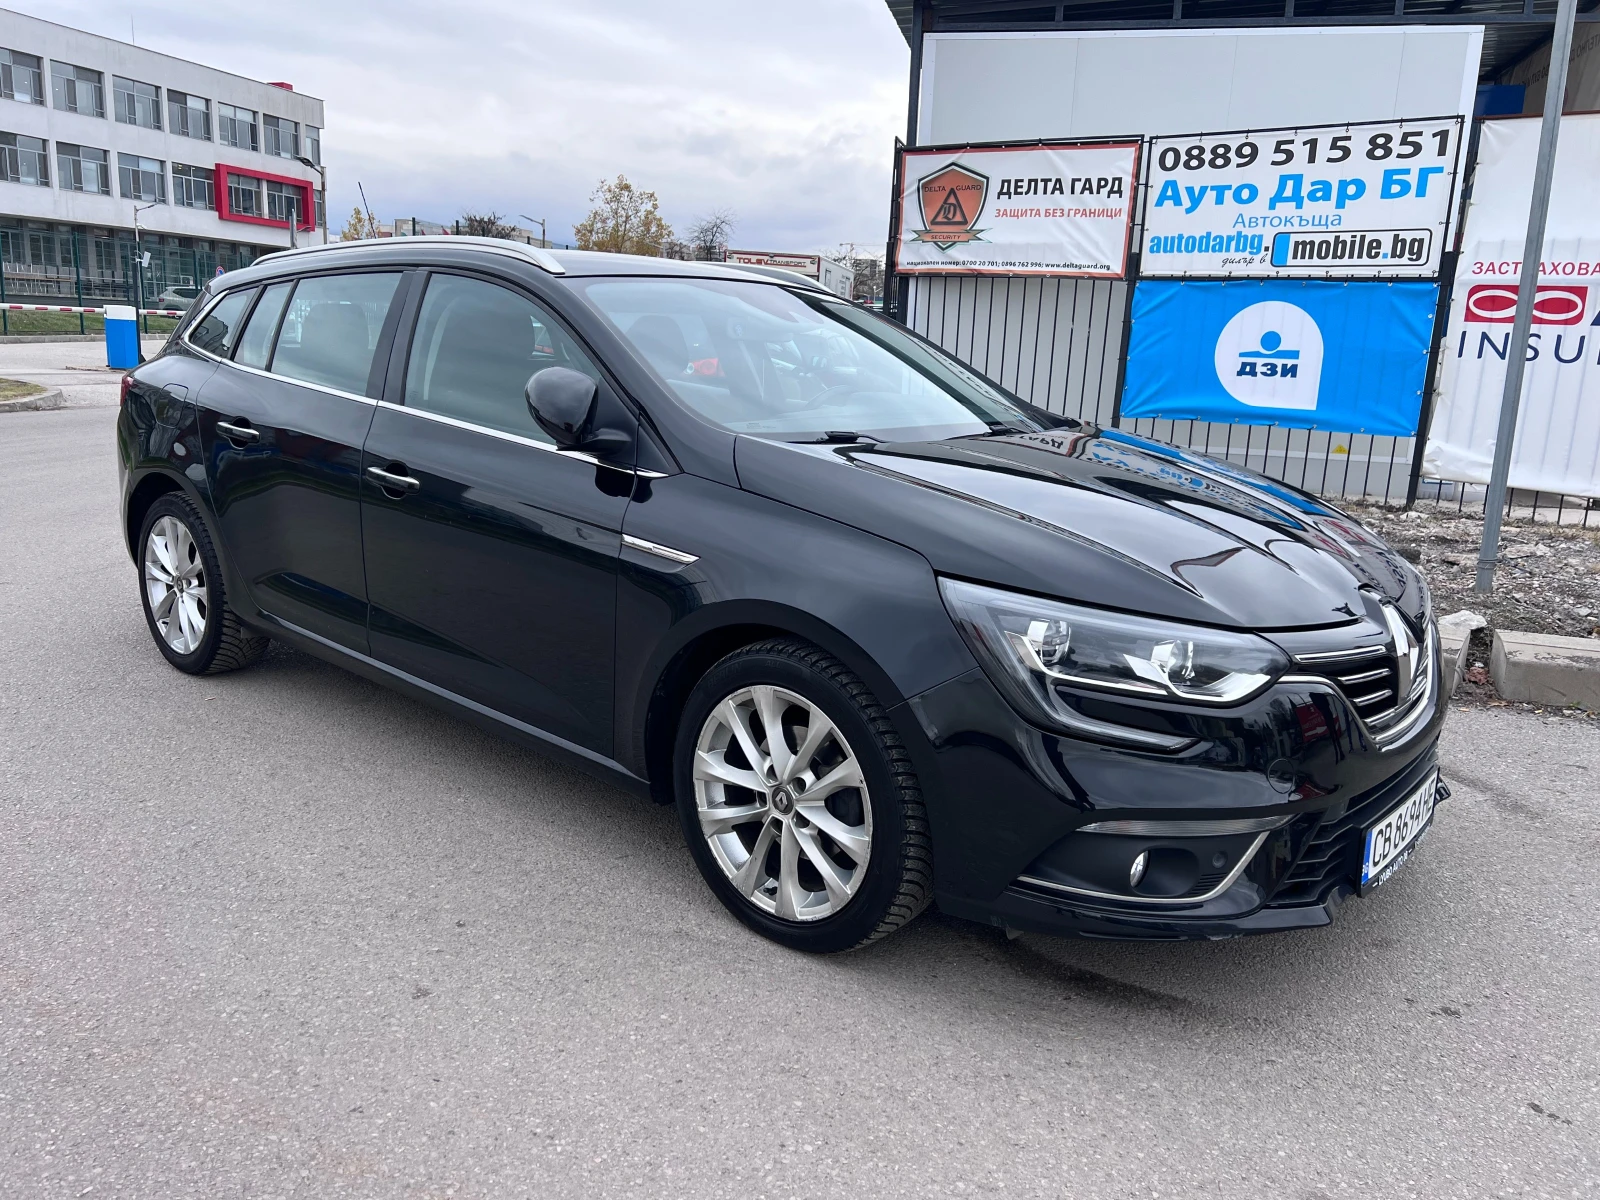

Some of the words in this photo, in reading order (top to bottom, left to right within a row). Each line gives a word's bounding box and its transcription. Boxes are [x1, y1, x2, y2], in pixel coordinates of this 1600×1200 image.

[1158, 141, 1259, 172] 0889
[1270, 135, 1353, 167] 515
[1365, 129, 1450, 161] 851
[924, 185, 947, 193] DELTA
[997, 178, 1068, 200] ДЕЛТА
[1070, 176, 1123, 199] ГАРД
[1154, 178, 1259, 214] Ауто
[1268, 173, 1366, 210] Дар
[1380, 166, 1445, 200] БГ
[995, 208, 1041, 220] ЗАЩИТА
[1044, 208, 1065, 218] БЕЗ
[1067, 207, 1122, 220] ГРАНИЦИ
[1232, 213, 1342, 229] Автокъща
[1291, 233, 1425, 262] mobile.bg
[1045, 262, 1111, 270] www.deltaguard.org
[1472, 261, 1600, 276] ЗАСТАХОВА
[1457, 330, 1600, 365] INSU
